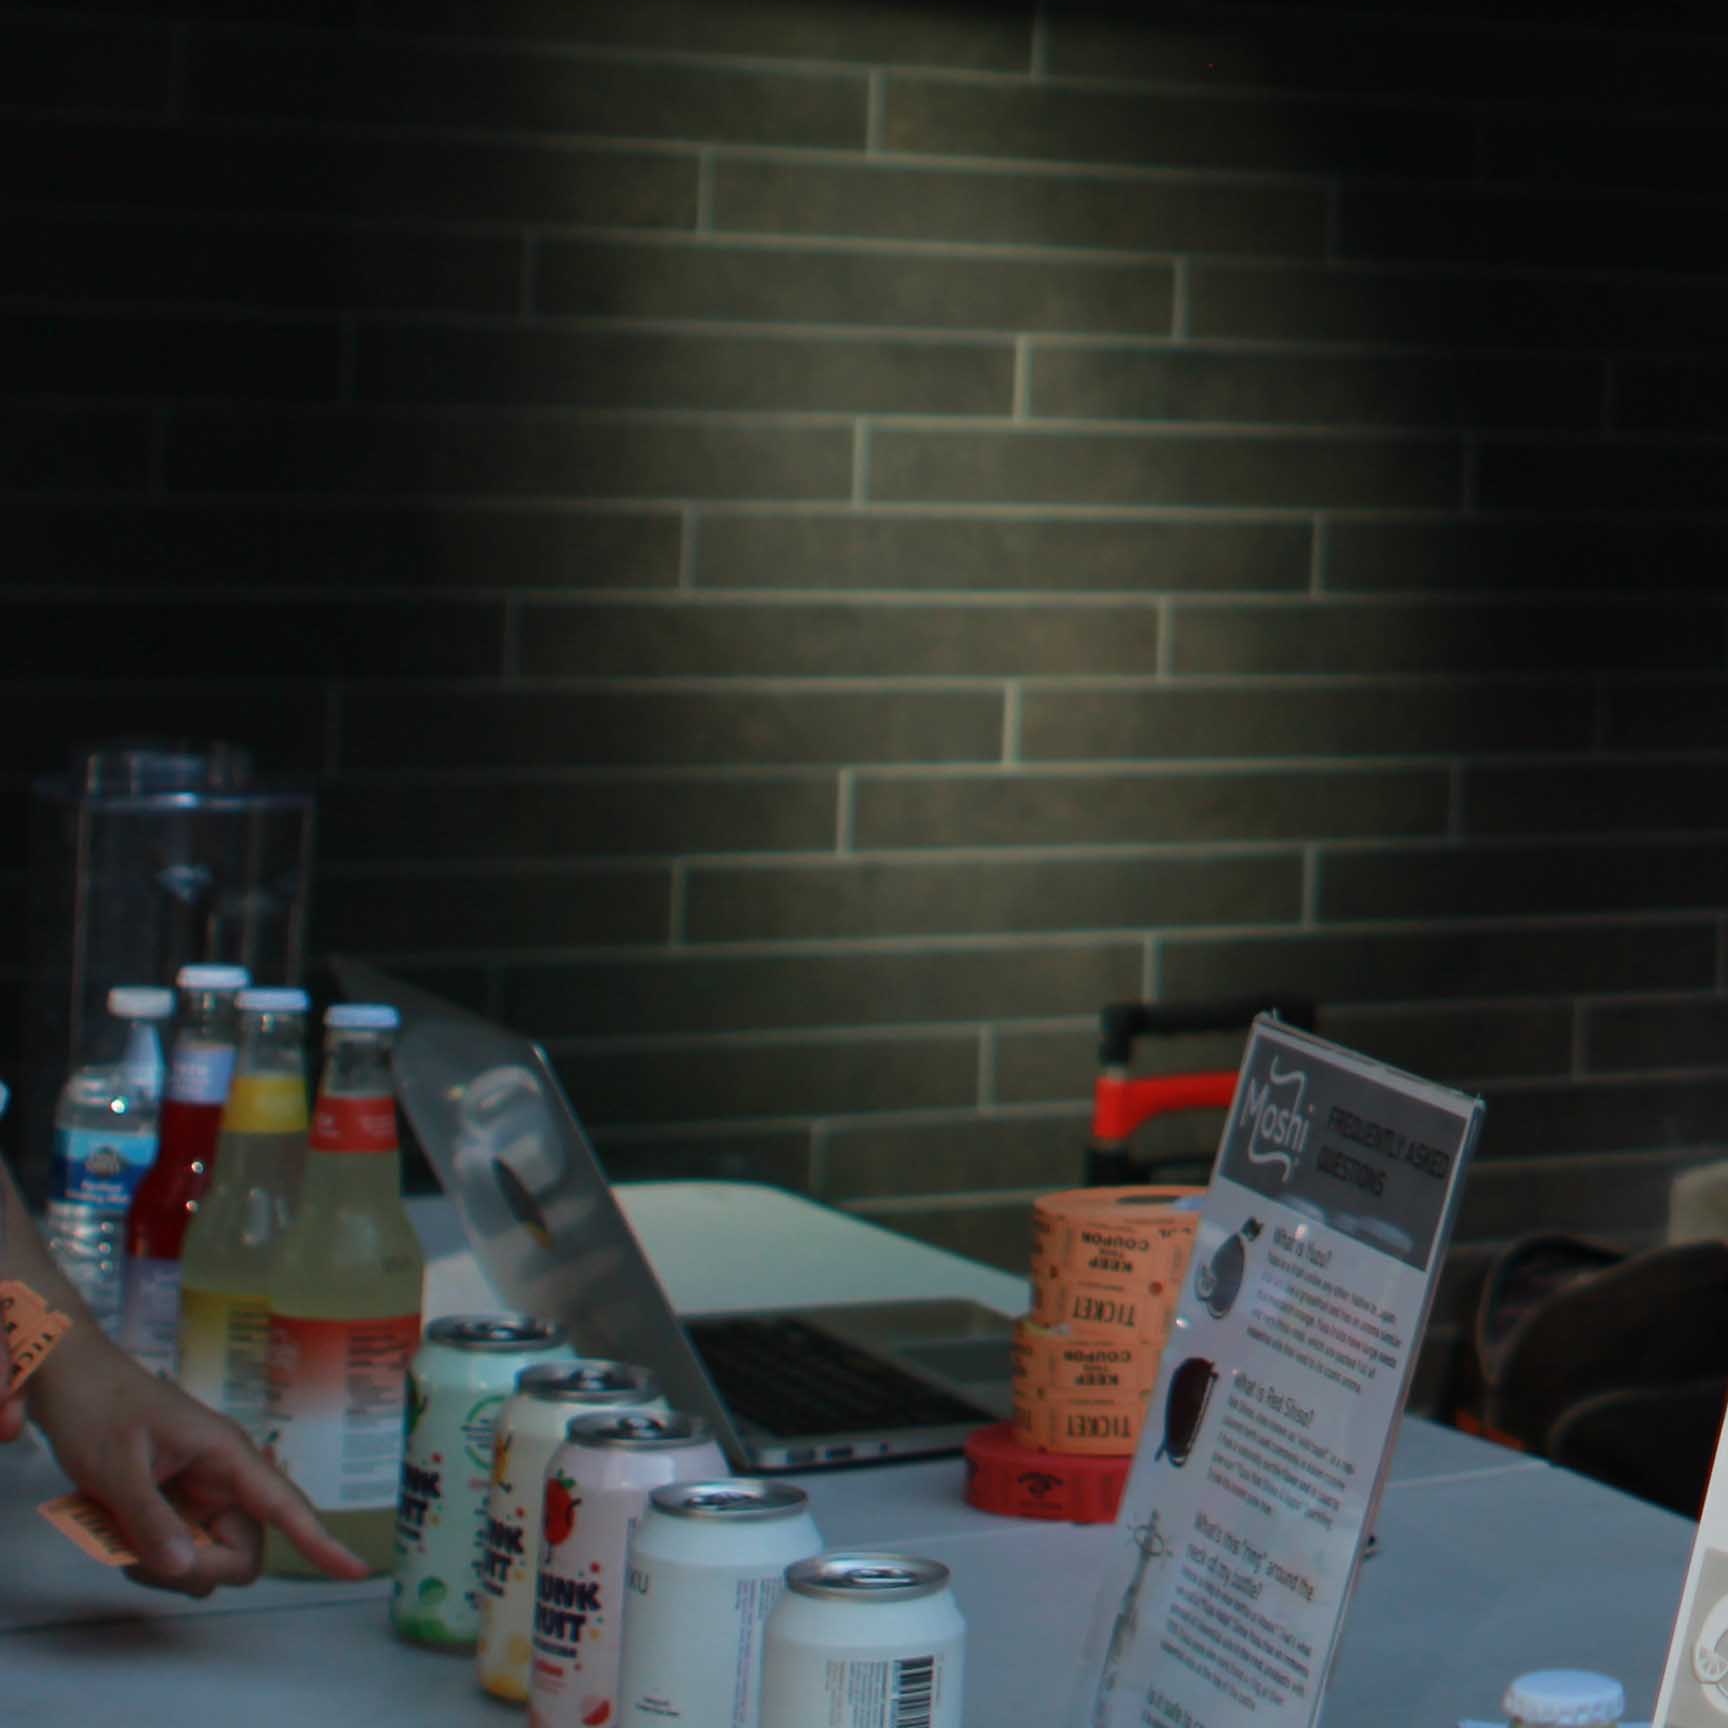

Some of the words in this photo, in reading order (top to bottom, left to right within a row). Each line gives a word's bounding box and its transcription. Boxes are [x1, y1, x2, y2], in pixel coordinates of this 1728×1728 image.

[1239, 1055, 1314, 1183] Moshi
[1081, 1231, 1150, 1253] COUPON
[1087, 1258, 1133, 1273] KEEP
[1072, 1295, 1136, 1329] TICKET
[1063, 1349, 1132, 1364] COUPON
[1073, 1373, 1119, 1387] KEEP
[1066, 1415, 1131, 1440] TICKET
